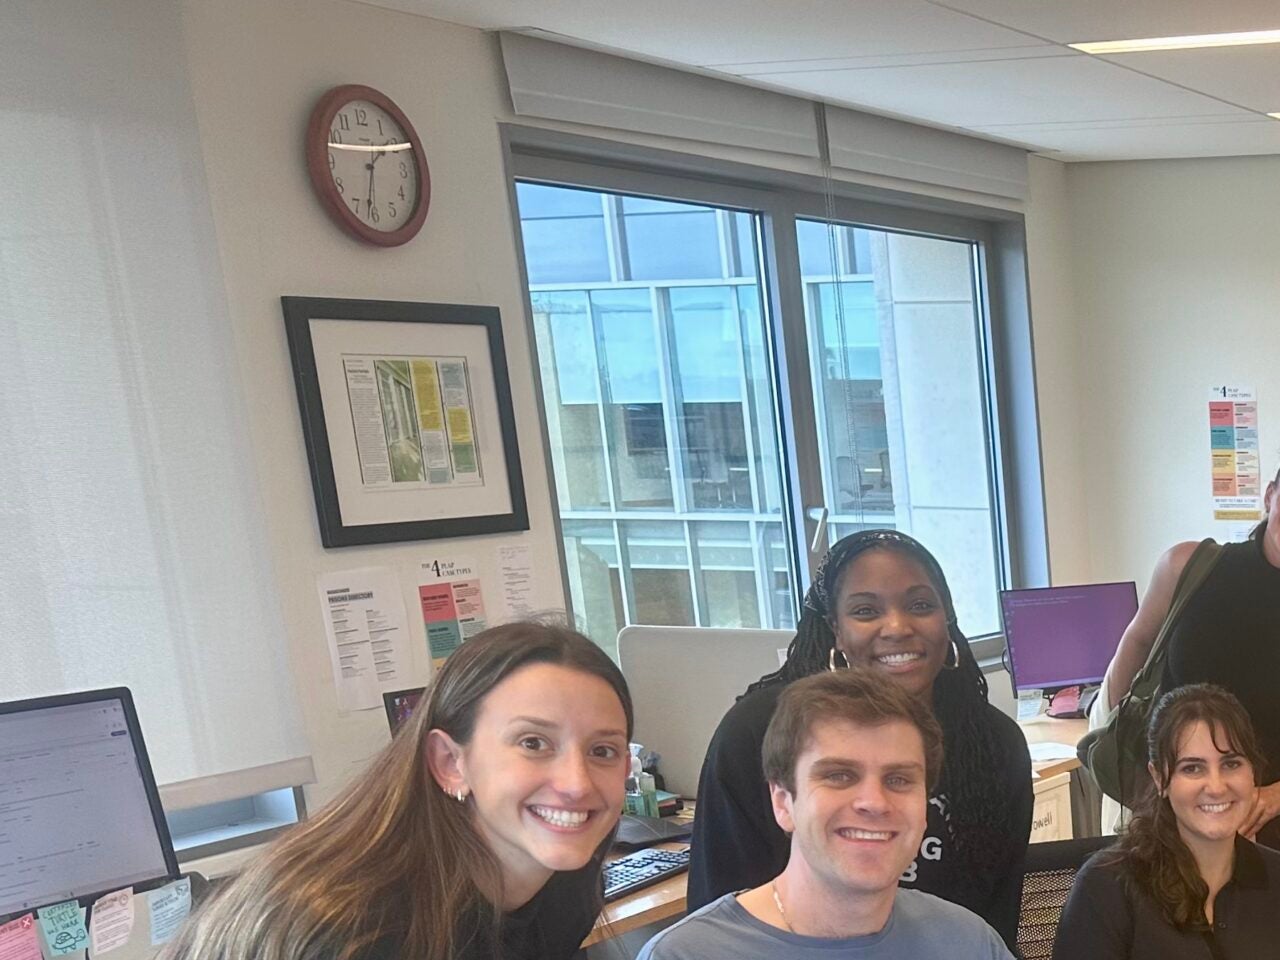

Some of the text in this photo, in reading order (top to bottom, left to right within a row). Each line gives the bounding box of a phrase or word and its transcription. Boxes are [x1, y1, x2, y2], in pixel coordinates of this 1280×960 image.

[338, 113, 350, 131] 11
[354, 109, 368, 126] 12
[377, 119, 384, 136] 1
[399, 162, 408, 179] 3
[335, 177, 345, 194] 8
[397, 185, 406, 201] 4
[352, 198, 360, 214] 7
[388, 202, 397, 218] 5
[371, 207, 380, 223] 6
[1220, 385, 1227, 398] 4
[431, 560, 441, 577] 4
